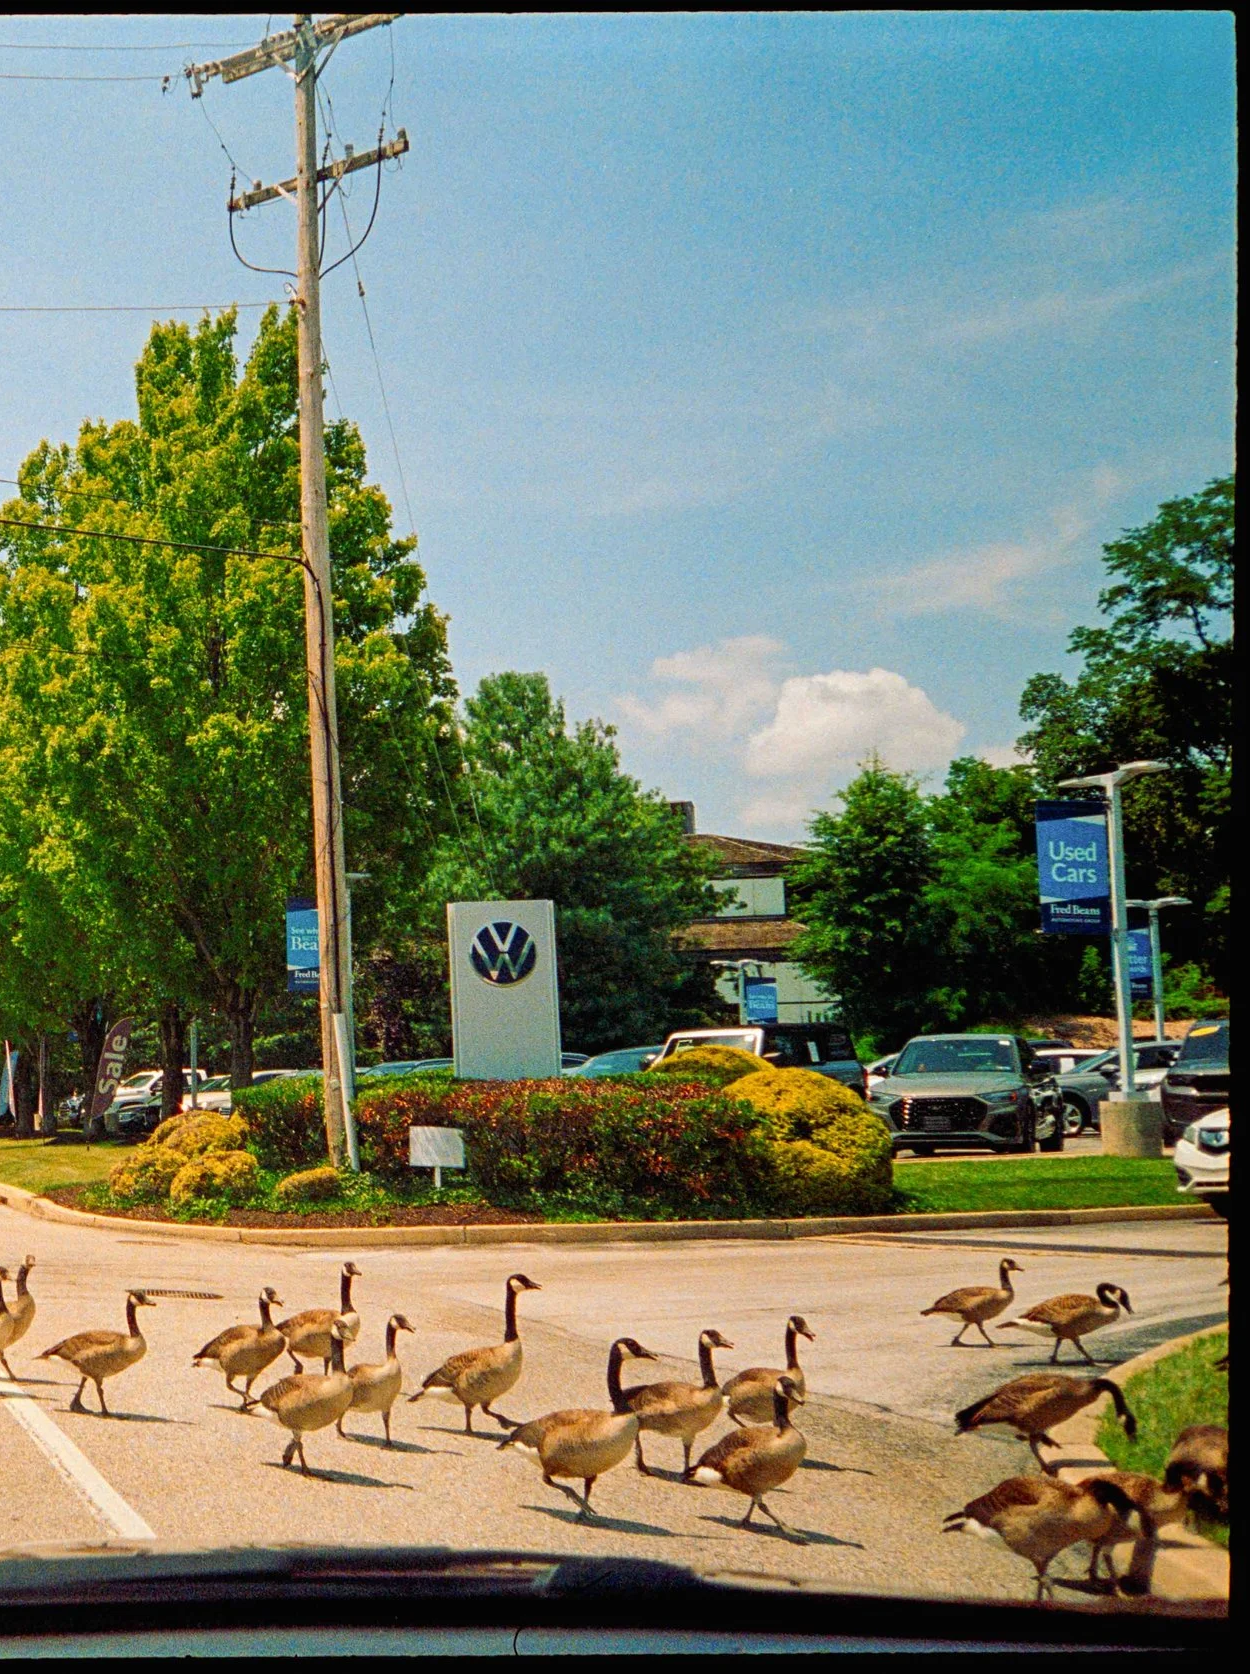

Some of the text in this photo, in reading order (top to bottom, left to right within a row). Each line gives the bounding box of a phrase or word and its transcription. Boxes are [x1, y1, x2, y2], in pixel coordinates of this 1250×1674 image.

[1049, 841, 1097, 861] Used
[1051, 862, 1097, 883] Cars
[1051, 904, 1100, 915] Fred Beans
[306, 926, 318, 935] wh
[291, 936, 318, 951] Bea
[294, 970, 310, 978] Fred
[99, 1034, 128, 1095] Sale
